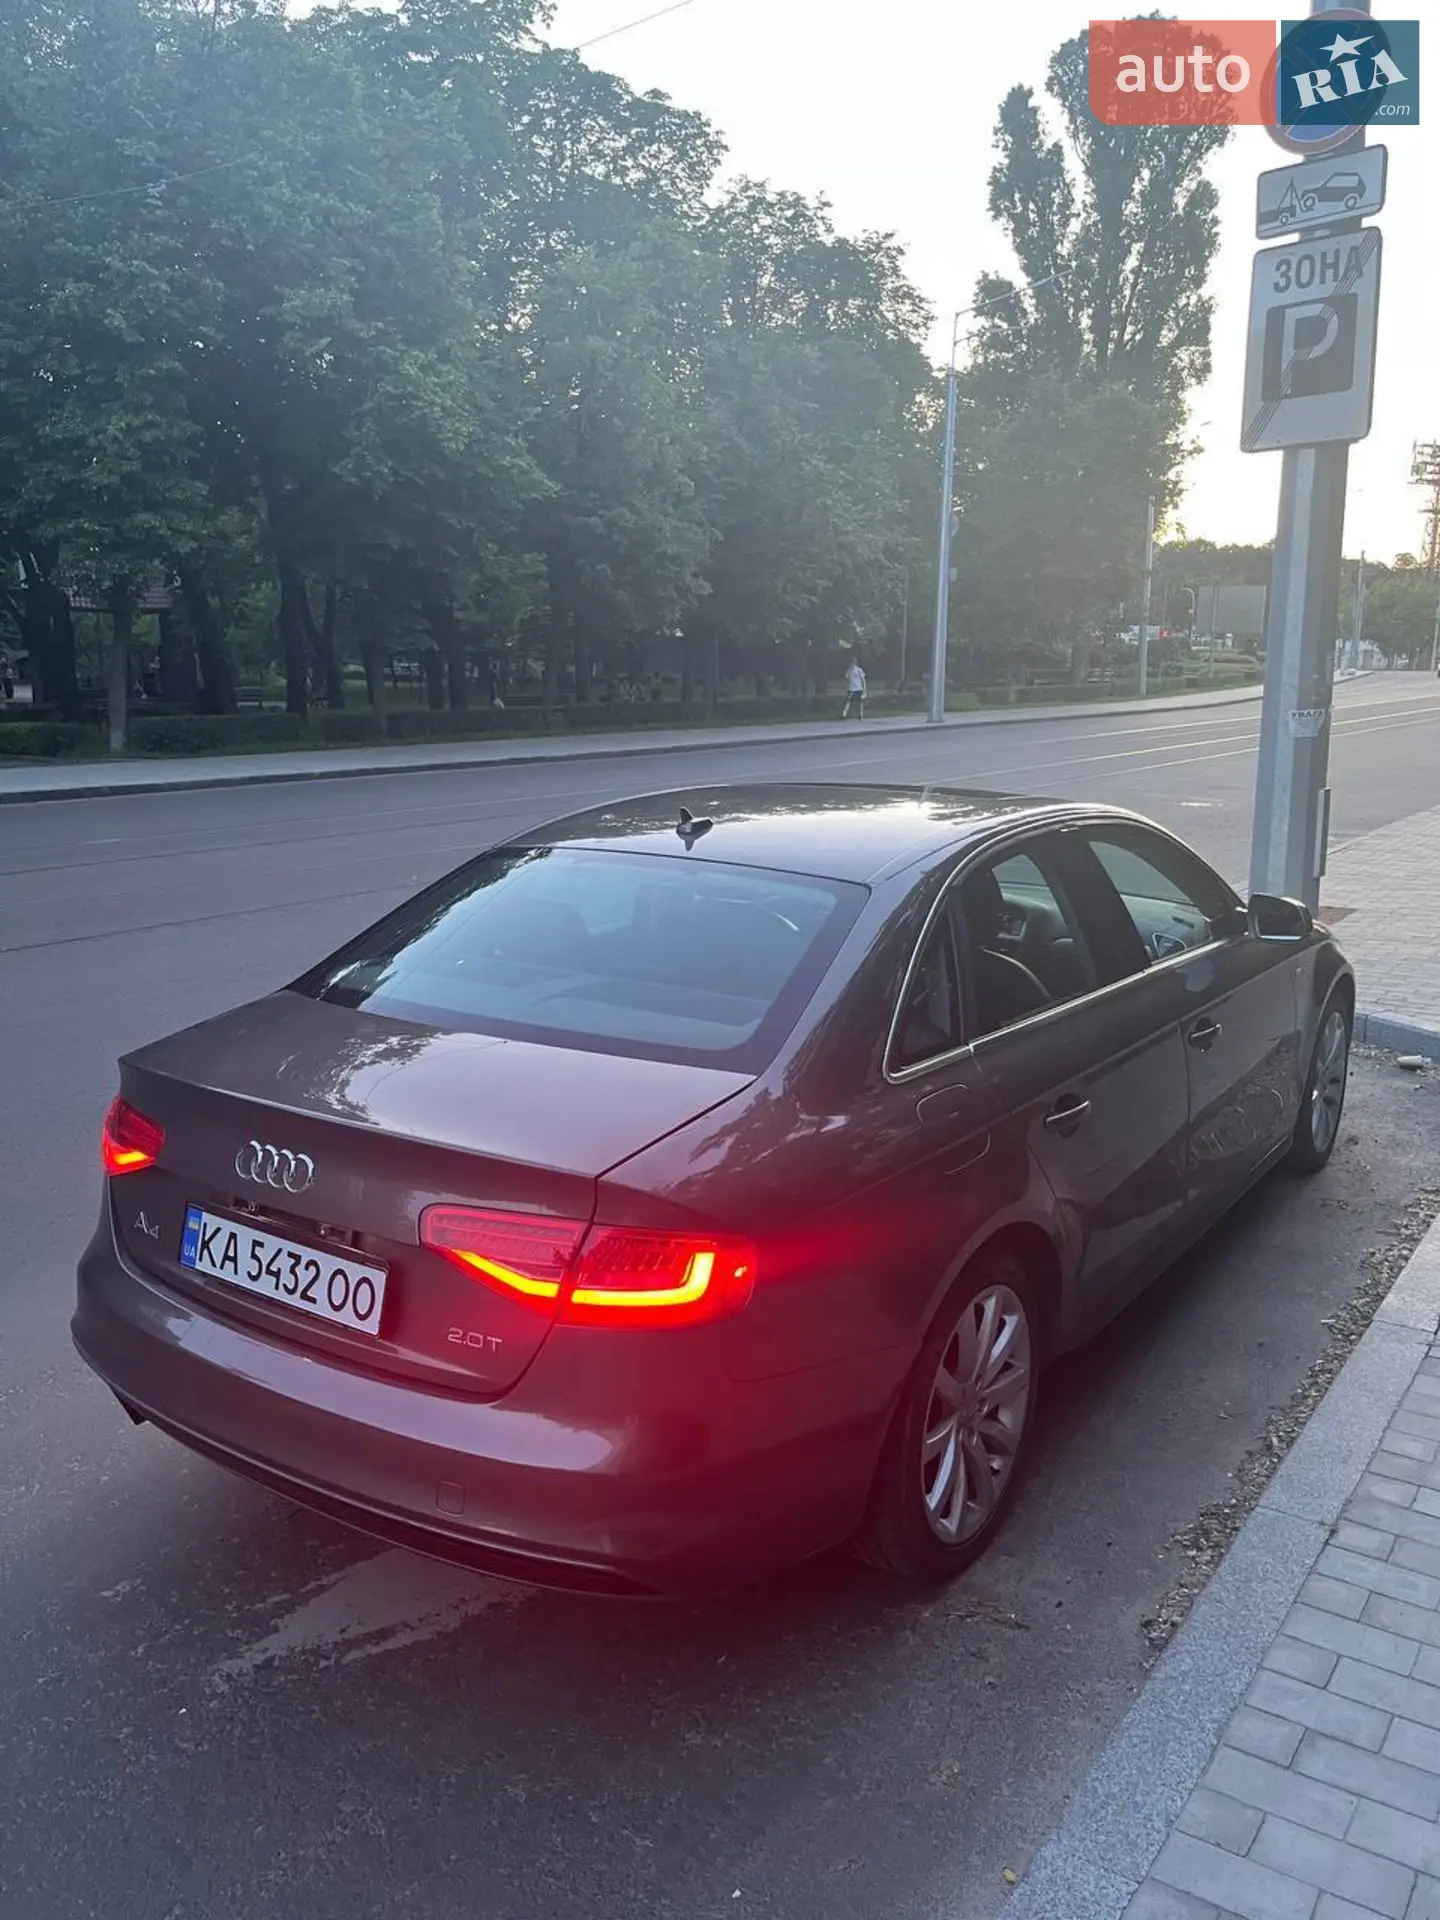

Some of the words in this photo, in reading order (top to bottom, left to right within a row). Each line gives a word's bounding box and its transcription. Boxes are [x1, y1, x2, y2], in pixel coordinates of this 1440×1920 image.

[1273, 245, 1365, 294] ЗОНА
[1281, 302, 1339, 394] P
[133, 1210, 160, 1239] A4
[183, 1243, 196, 1258] UA
